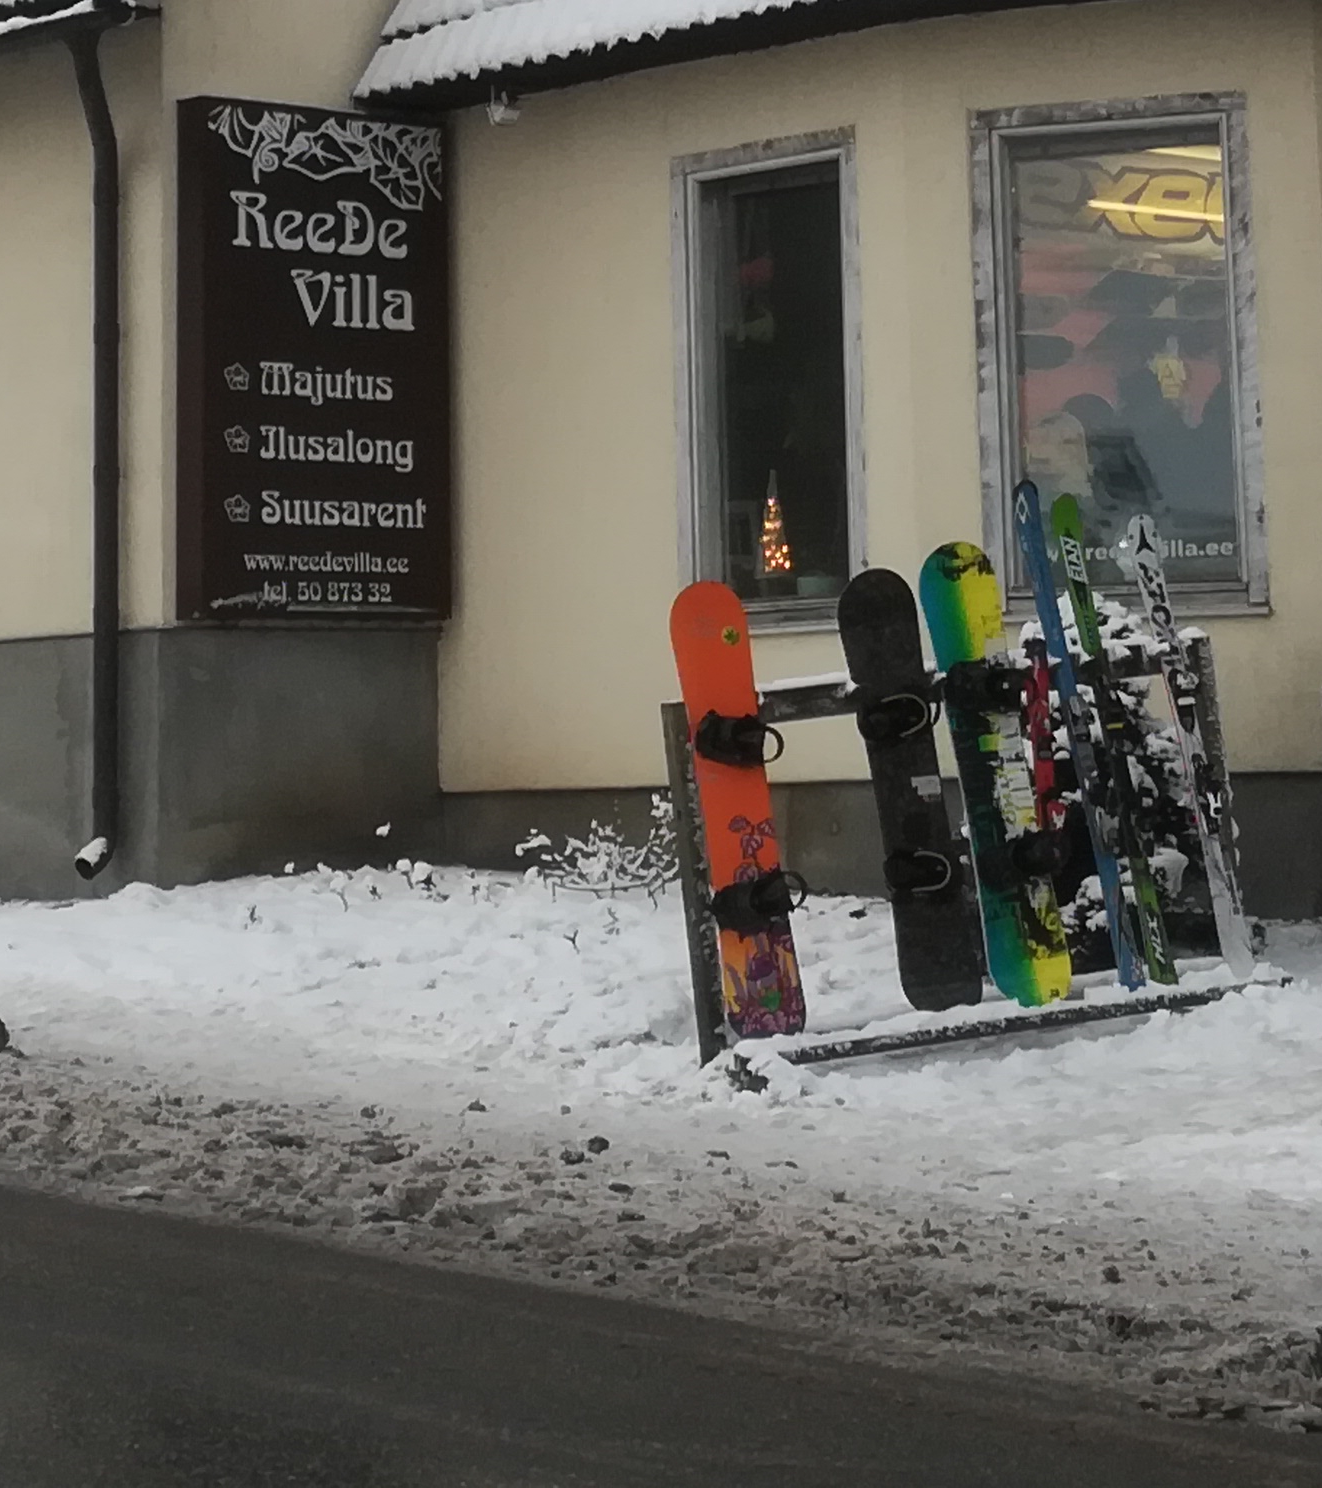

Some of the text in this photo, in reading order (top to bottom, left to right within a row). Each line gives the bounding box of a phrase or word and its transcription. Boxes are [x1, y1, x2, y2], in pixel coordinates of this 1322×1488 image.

[291, 269, 415, 331] Villa
[260, 361, 394, 406] Majutus
[260, 425, 414, 473] Ilusalong
[260, 490, 427, 529] Suusarent
[243, 551, 410, 574] www.reedevilla.ee
[297, 581, 322, 602] 50
[327, 582, 363, 602] 873
[368, 582, 393, 602] 32
